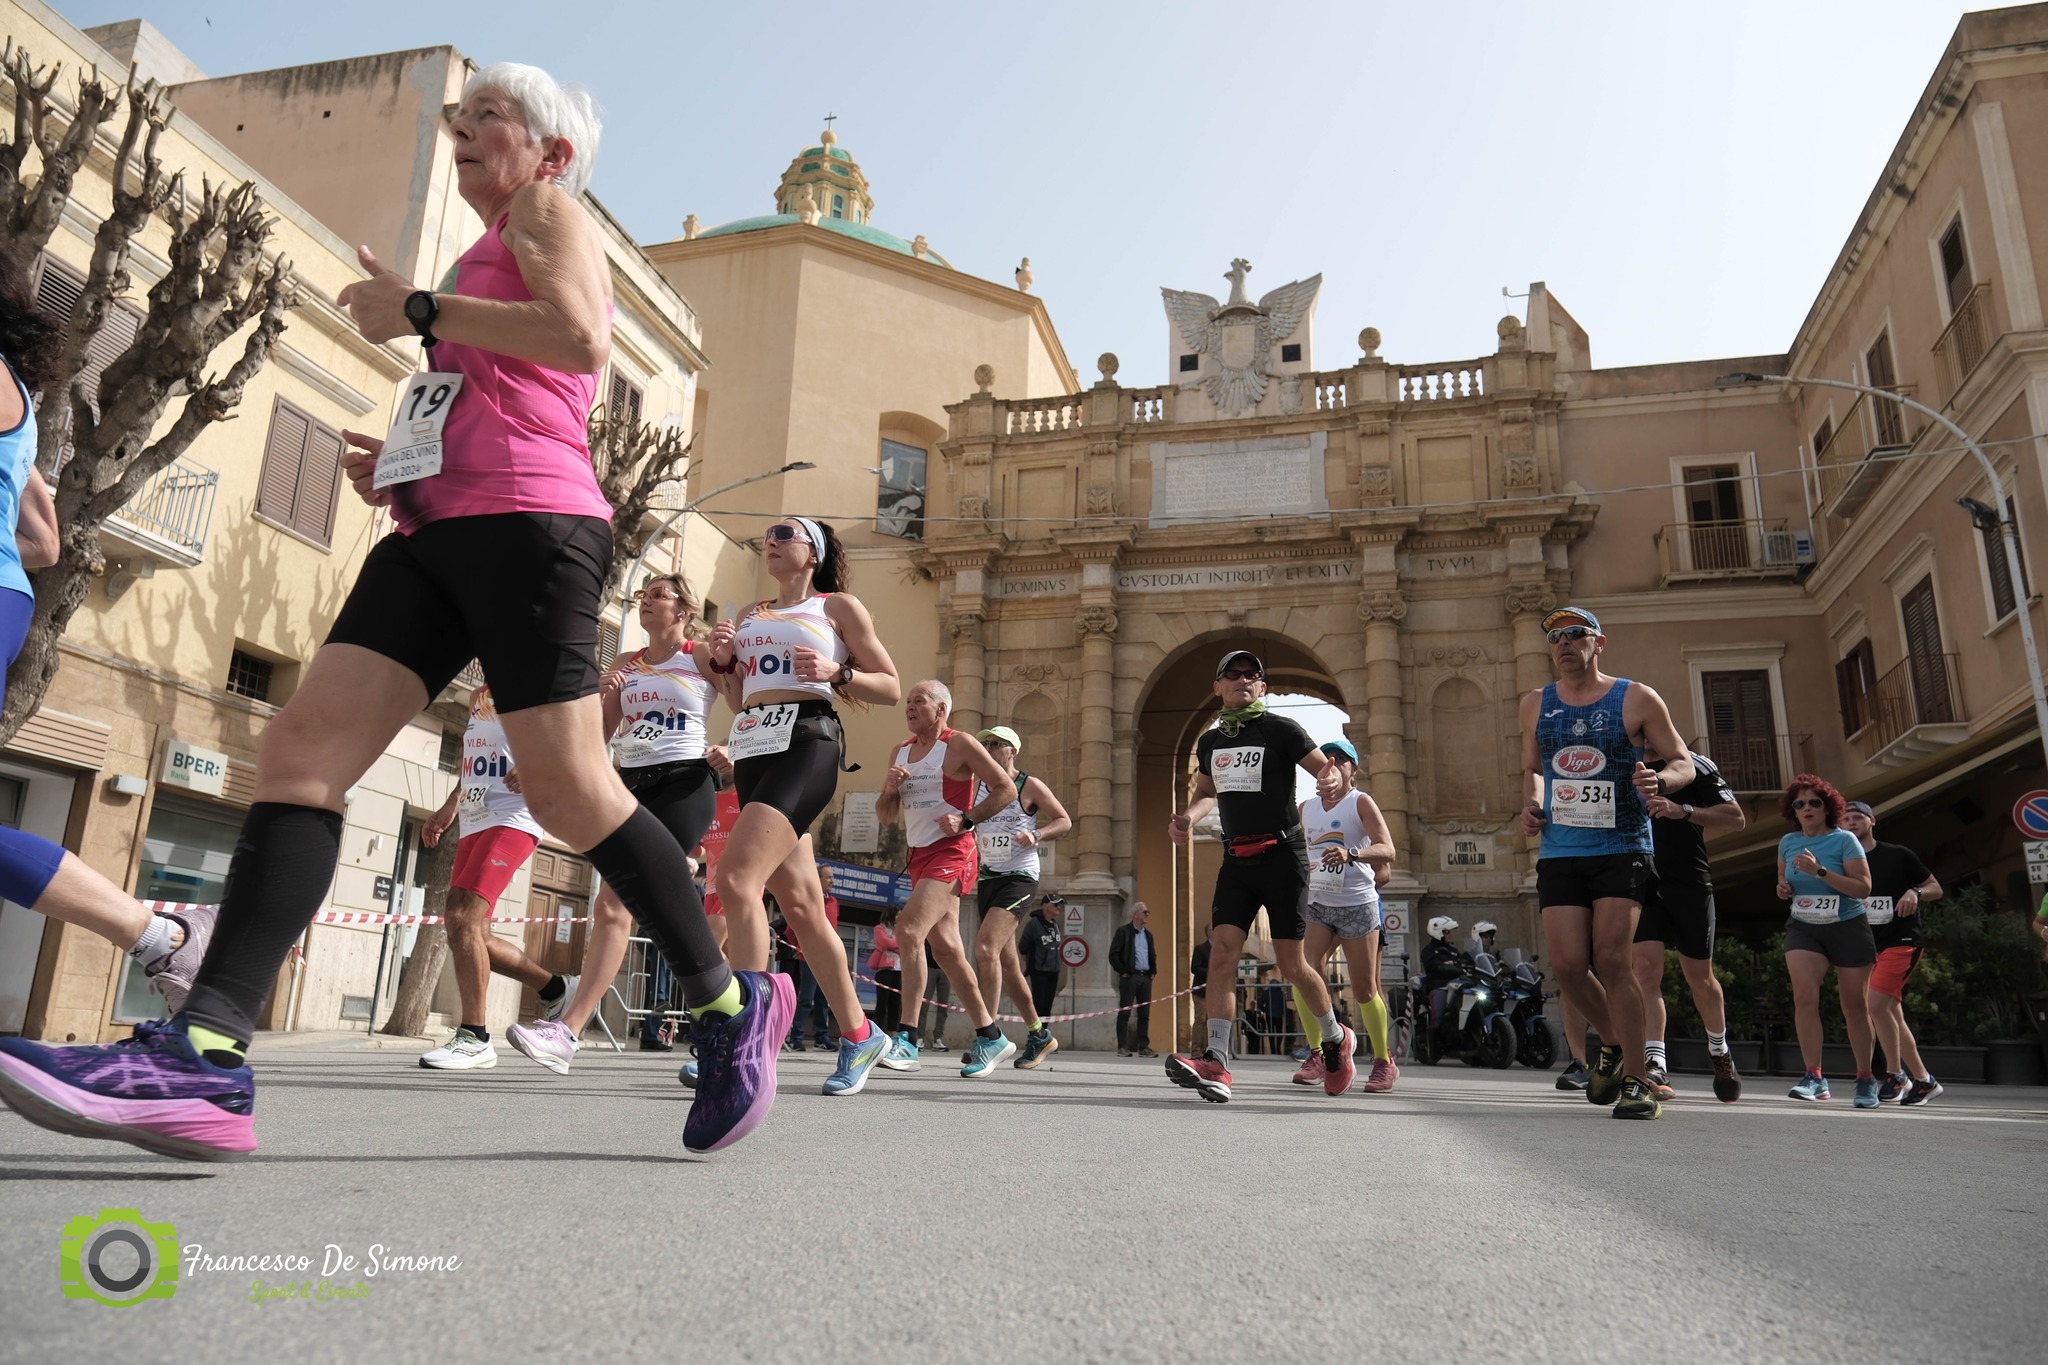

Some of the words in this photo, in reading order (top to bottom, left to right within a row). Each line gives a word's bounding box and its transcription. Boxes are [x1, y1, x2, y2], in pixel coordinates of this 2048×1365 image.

[416, 444, 438, 458] VINO
[400, 464, 422, 476] 2024
[1004, 579, 1066, 594] DOMINVS
[1119, 573, 1202, 588] CVSTODIAT
[1285, 566, 1302, 580] ET
[1427, 556, 1476, 572] TVVM
[762, 710, 794, 728] 451
[632, 724, 663, 740] 438
[740, 741, 768, 750] MARATONINA
[747, 748, 768, 756] MARSALA
[1234, 752, 1261, 768] 349
[1562, 751, 1597, 772] Sigel
[170, 770, 190, 782] Banca
[466, 788, 486, 802] 439
[1580, 786, 1612, 804] 534
[992, 836, 1010, 848] 152
[1454, 841, 1477, 852] PORTA
[2031, 864, 2042, 872] SU
[2032, 874, 2042, 882] LA
[1815, 898, 1837, 909] 231
[1870, 900, 1890, 910] 421
